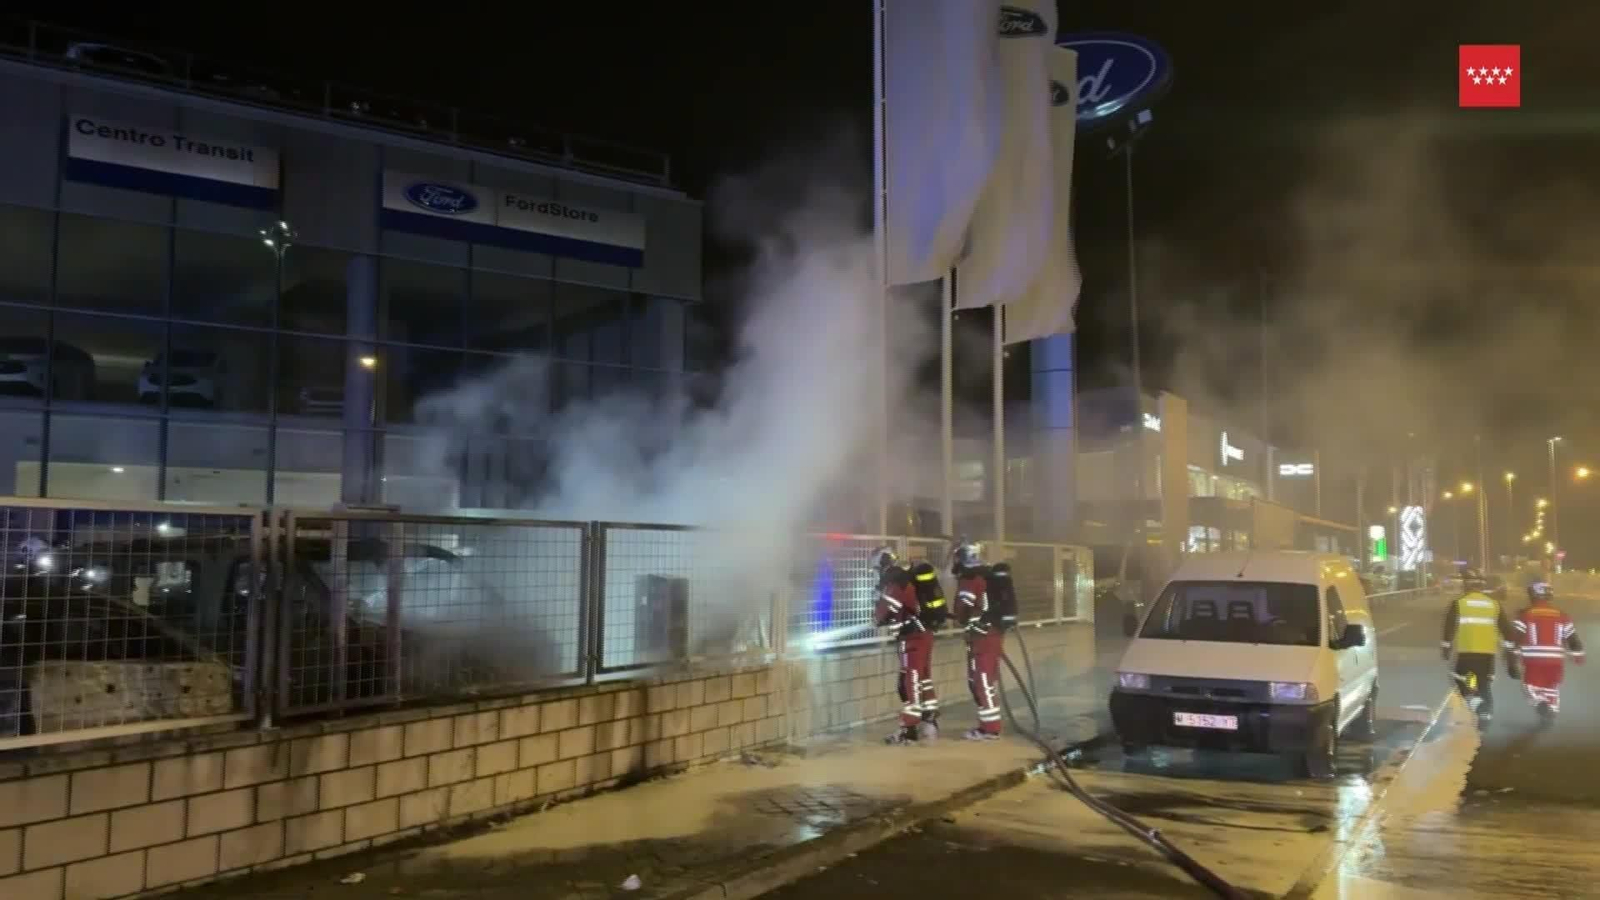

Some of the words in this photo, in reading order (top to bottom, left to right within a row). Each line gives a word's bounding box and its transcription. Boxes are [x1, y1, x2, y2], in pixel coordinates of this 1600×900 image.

[75, 118, 166, 147] Centro
[173, 134, 254, 163] Transit
[418, 185, 466, 213] Ford
[505, 194, 600, 223] FordStore
